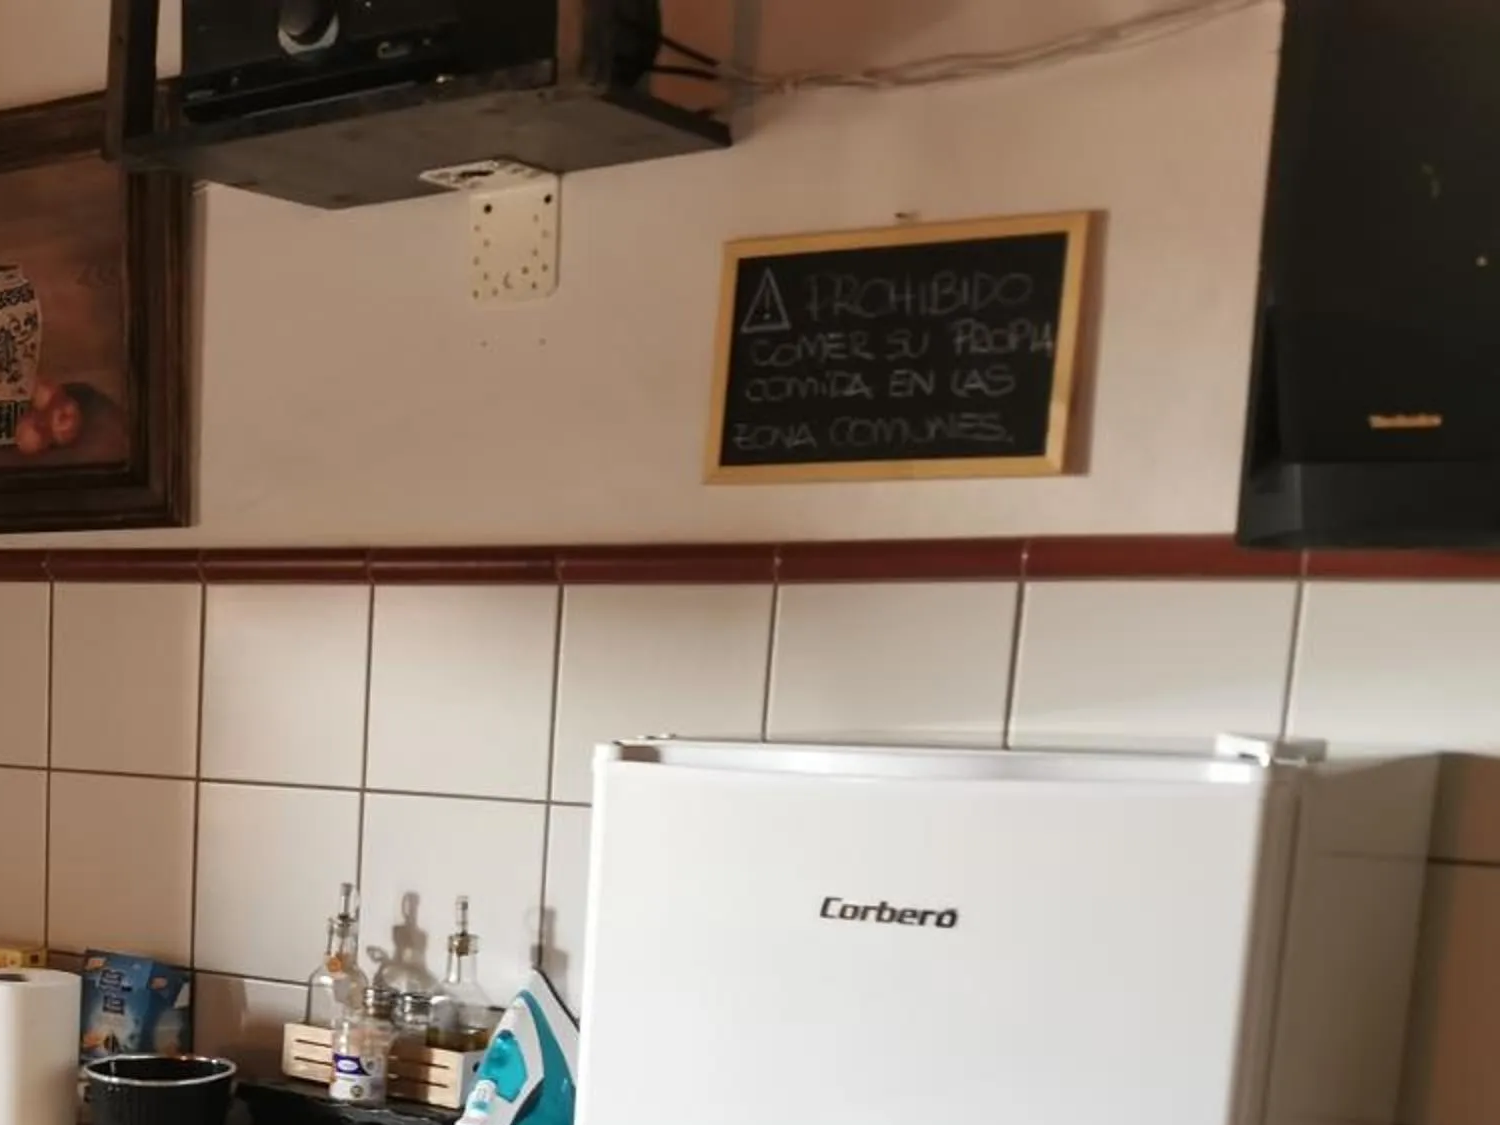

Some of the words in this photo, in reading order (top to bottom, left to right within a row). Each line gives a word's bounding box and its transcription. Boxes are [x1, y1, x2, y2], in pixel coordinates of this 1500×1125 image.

[805, 269, 1033, 319] PROHIBIDO
[749, 331, 875, 367] COMER
[884, 329, 930, 362] SU
[888, 368, 935, 399] EN
[950, 363, 1016, 399] LAS
